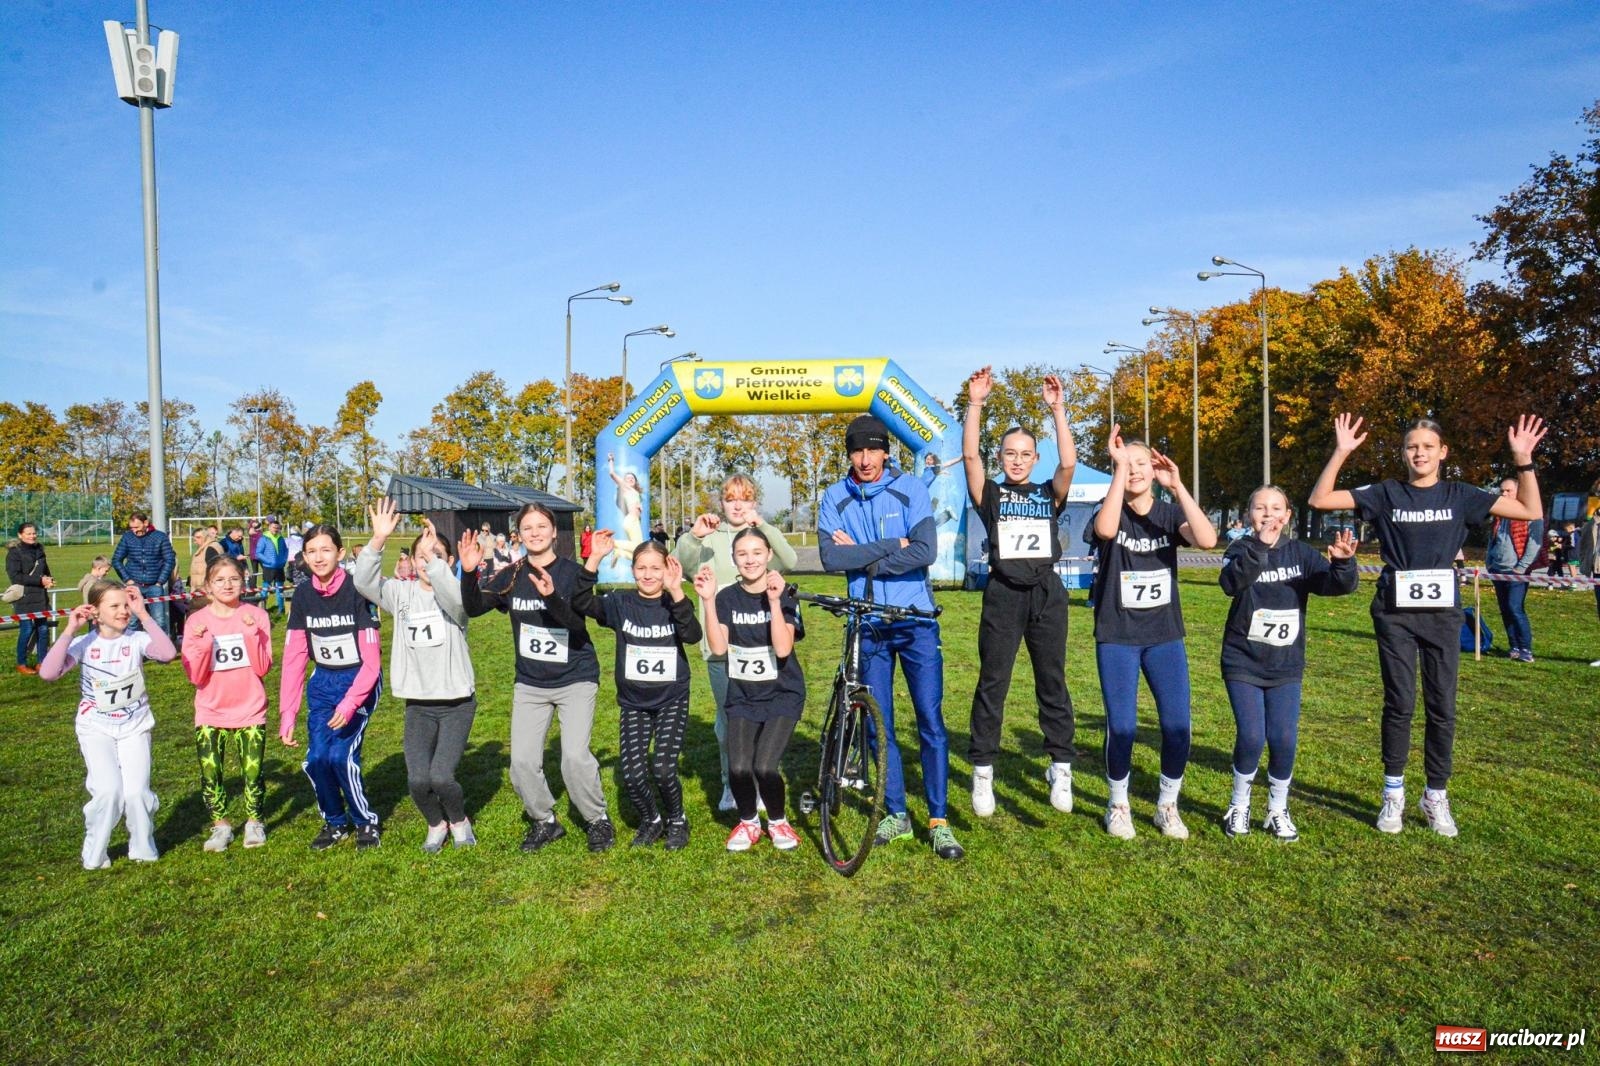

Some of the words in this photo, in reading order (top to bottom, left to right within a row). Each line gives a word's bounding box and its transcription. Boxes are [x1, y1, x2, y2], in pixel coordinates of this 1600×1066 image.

[751, 367, 807, 375] Gmina
[736, 377, 822, 388] Pietrowice
[747, 390, 811, 400] Wielkie
[615, 406, 647, 436] Gmina
[644, 379, 672, 407] ludzi
[888, 376, 920, 406] Gmina
[921, 405, 947, 432] ludzi
[628, 393, 682, 446] aktywnych
[877, 390, 933, 443] aktywnych
[1000, 503, 1052, 517] HANDBALL
[1391, 508, 1453, 522] HANDBALL
[1010, 534, 1040, 551] 72
[1133, 584, 1162, 601] 75
[1409, 583, 1442, 600] 83
[408, 624, 432, 641] 71
[1263, 623, 1290, 639] 78
[215, 646, 243, 664] 69
[320, 646, 344, 660] 81
[529, 638, 557, 655] 82
[636, 659, 666, 675] 64
[737, 659, 766, 675] 73
[104, 683, 134, 705] 77
